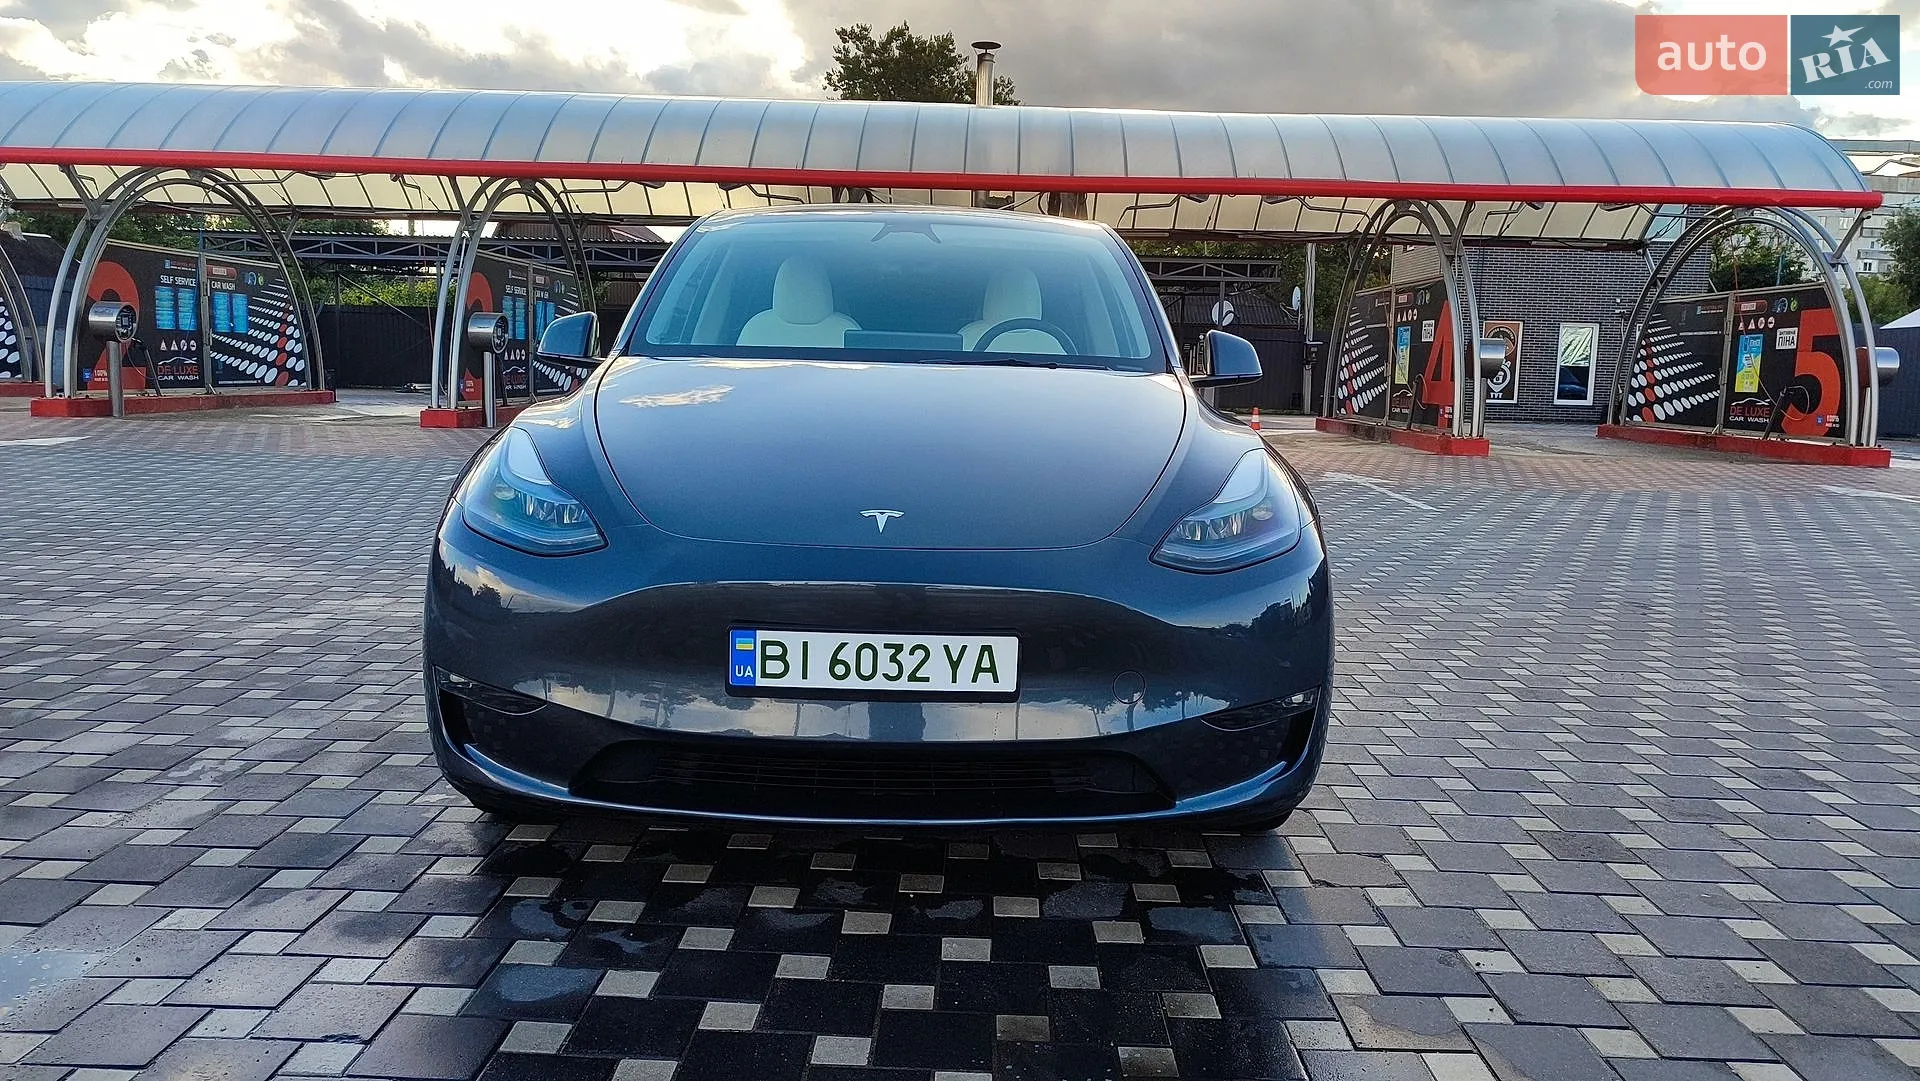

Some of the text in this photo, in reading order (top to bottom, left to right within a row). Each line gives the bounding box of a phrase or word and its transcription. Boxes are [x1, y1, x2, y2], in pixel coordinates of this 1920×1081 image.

[160, 274, 197, 287] SELF SERVICE
[211, 280, 236, 291] CAR WASH
[1778, 336, 1796, 347] ПІНА
[157, 365, 199, 375] DE LUXE
[1422, 299, 1454, 430] 4
[1780, 307, 1841, 437] 5
[1729, 406, 1770, 417] DE LUXE
[759, 639, 1000, 684] BI 6032 YA
[735, 664, 754, 678] UA
